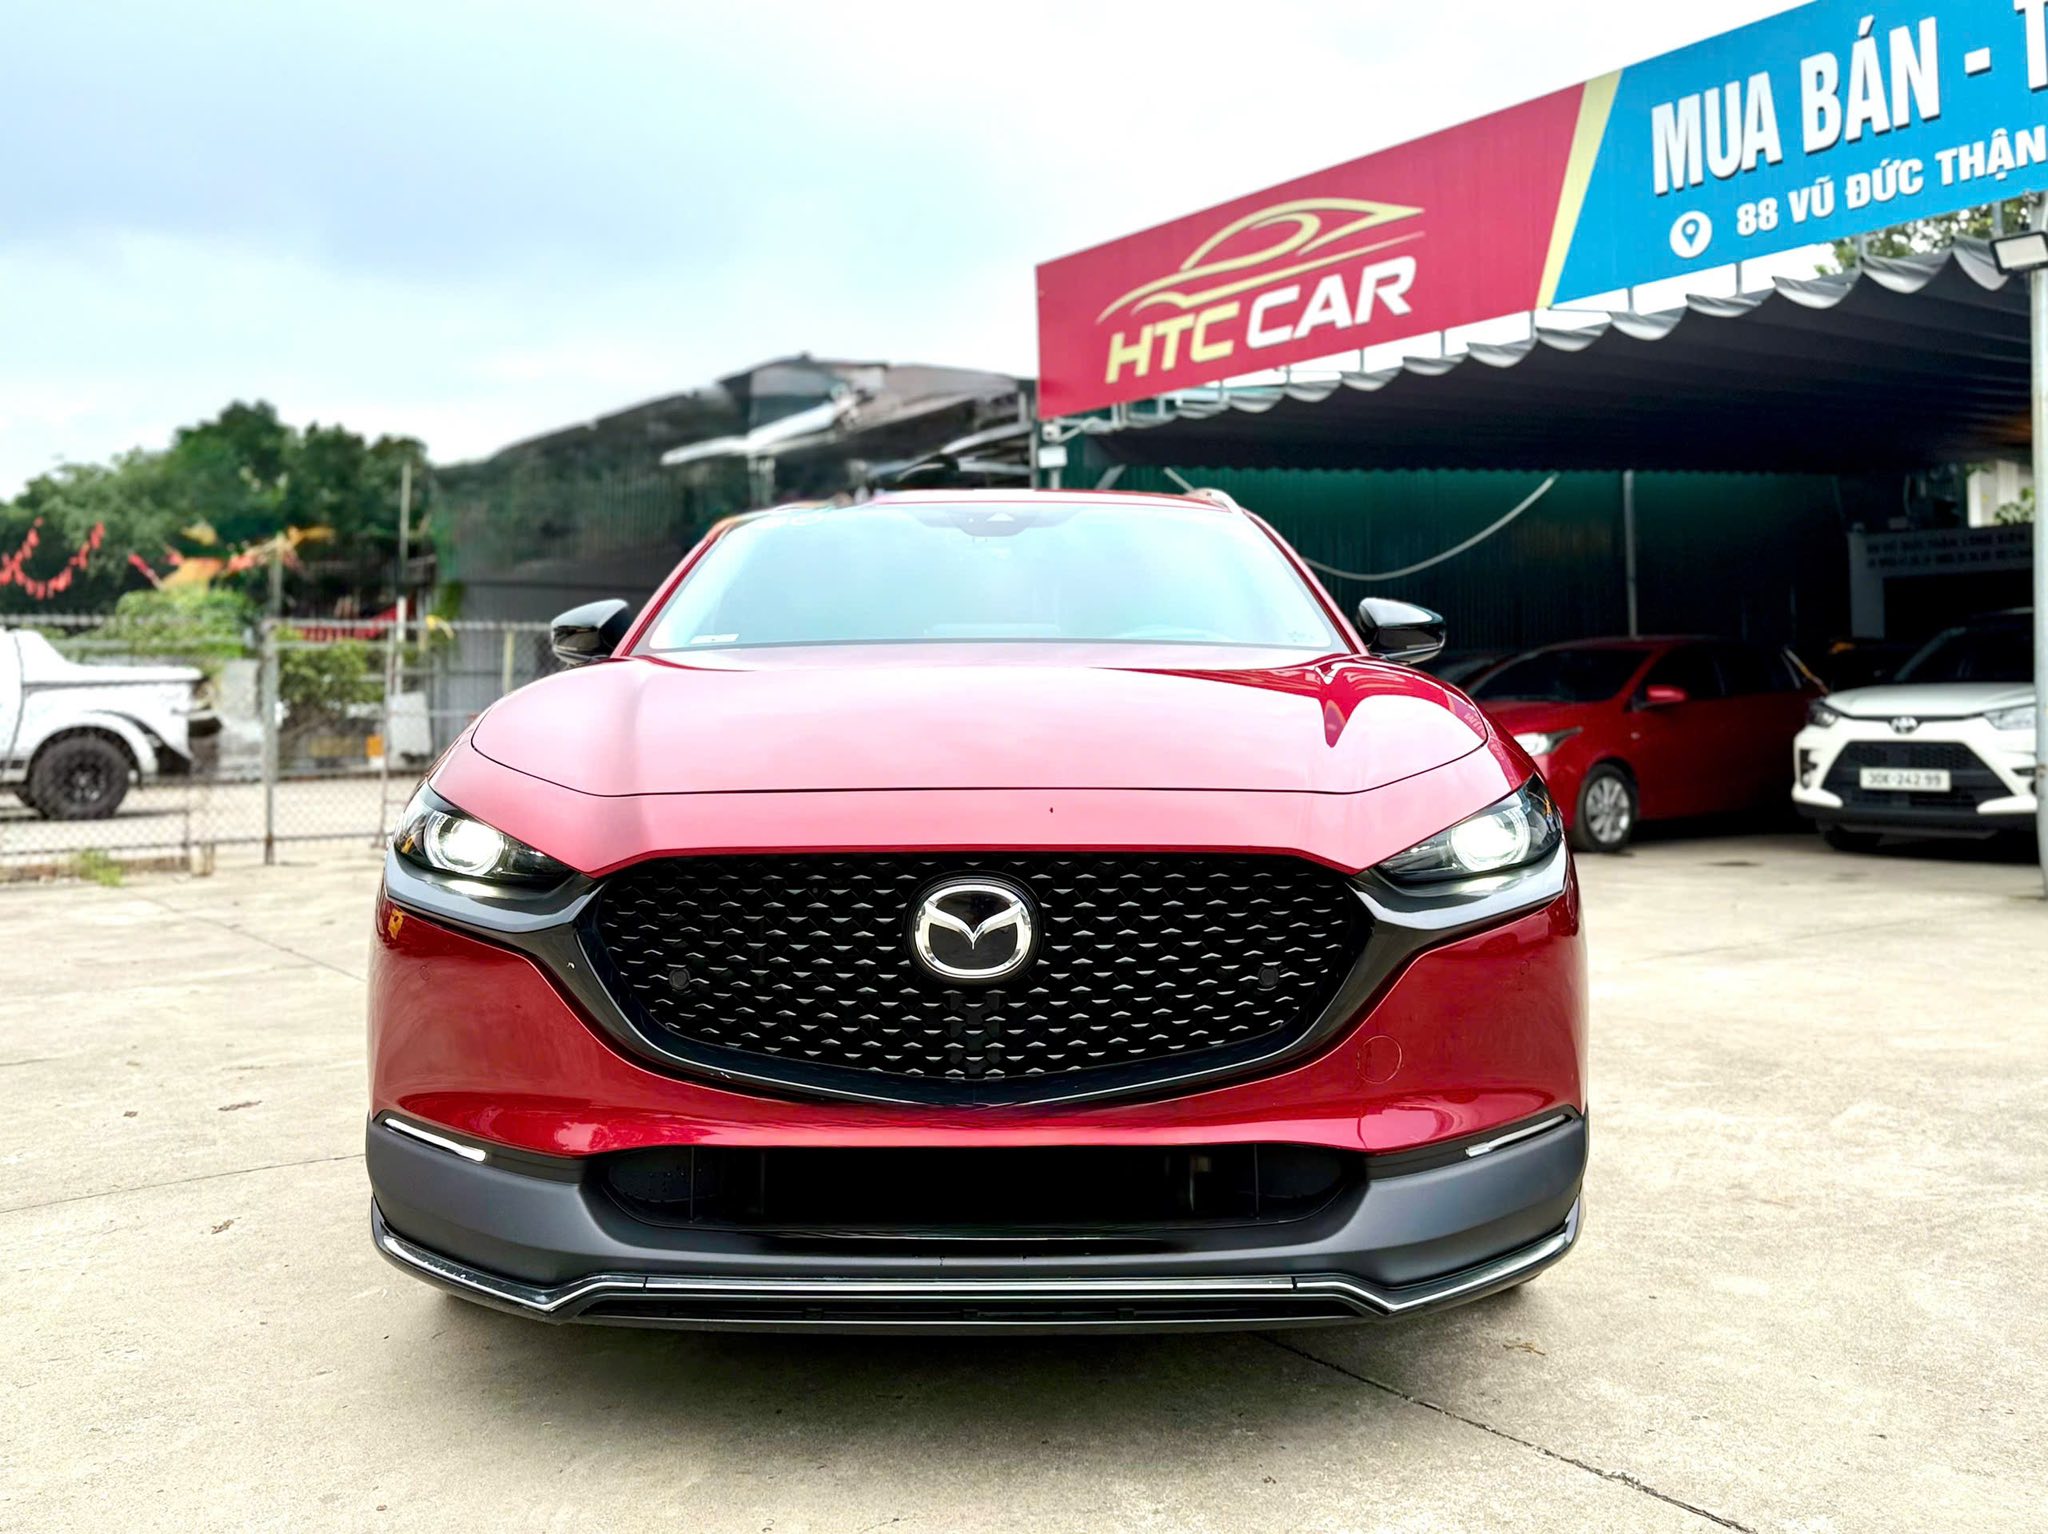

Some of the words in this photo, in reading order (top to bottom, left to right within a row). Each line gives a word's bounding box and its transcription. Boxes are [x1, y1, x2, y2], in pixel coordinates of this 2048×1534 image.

[1651, 71, 1783, 195] MUA
[1800, 14, 1940, 154] BÁN
[1737, 198, 1778, 236] 88
[1788, 176, 1834, 223] VŨ
[1845, 158, 1924, 210] ĐỨC
[1935, 125, 2047, 186] THẬN
[1105, 301, 1240, 384] HTC
[1246, 256, 1416, 349] CAR
